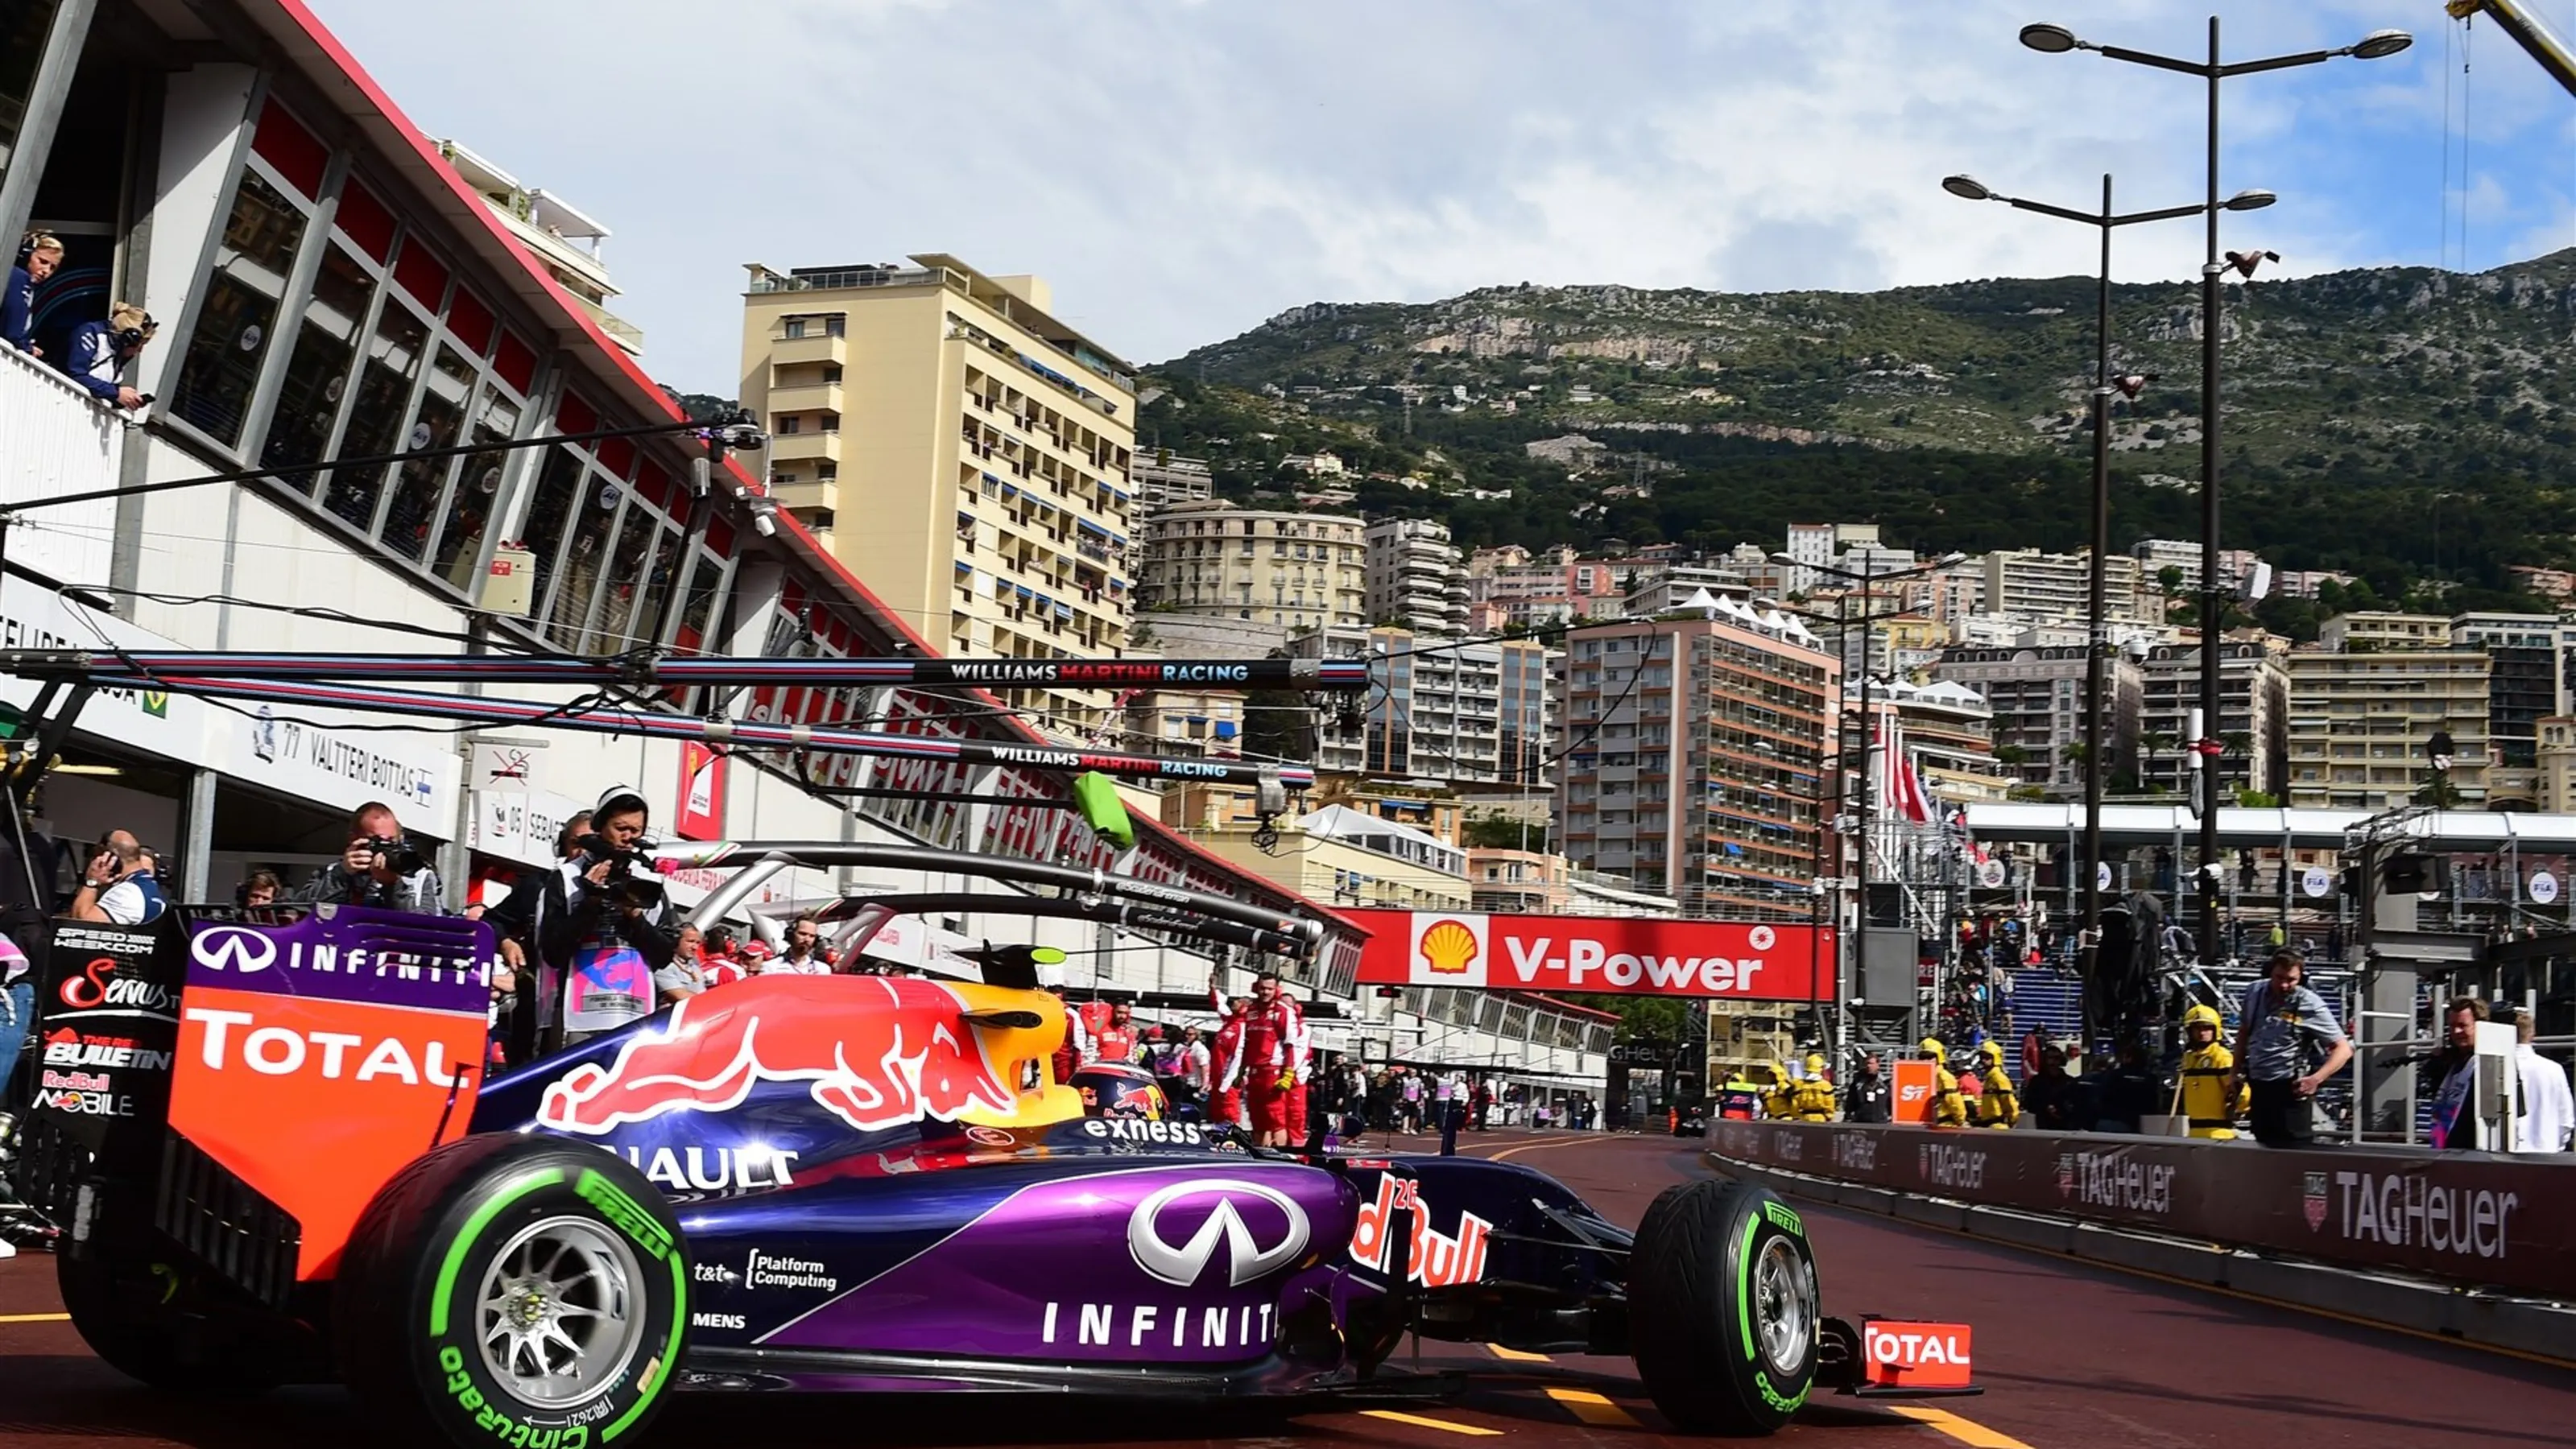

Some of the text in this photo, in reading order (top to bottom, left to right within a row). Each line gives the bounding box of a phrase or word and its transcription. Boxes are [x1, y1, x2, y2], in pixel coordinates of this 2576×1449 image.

[951, 663, 1249, 682] WILLIAMS MARTINI RACING
[283, 722, 300, 759] 77
[991, 745, 1228, 778] WILLIAMS MARTINI RACING
[56, 927, 126, 943] SPEED
[290, 941, 490, 987] INFINITI
[1503, 935, 1764, 991] V-Power
[83, 1034, 110, 1046] THE
[185, 1007, 469, 1089] TOTAL
[43, 1041, 172, 1071] BULLETIN
[31, 1088, 136, 1117] MOBILE
[1084, 1119, 1201, 1145] exness
[756, 1256, 824, 1274] Platform
[755, 1271, 837, 1292] Computing
[692, 1312, 746, 1329] MENS
[1864, 1327, 1970, 1365] TOTAL
